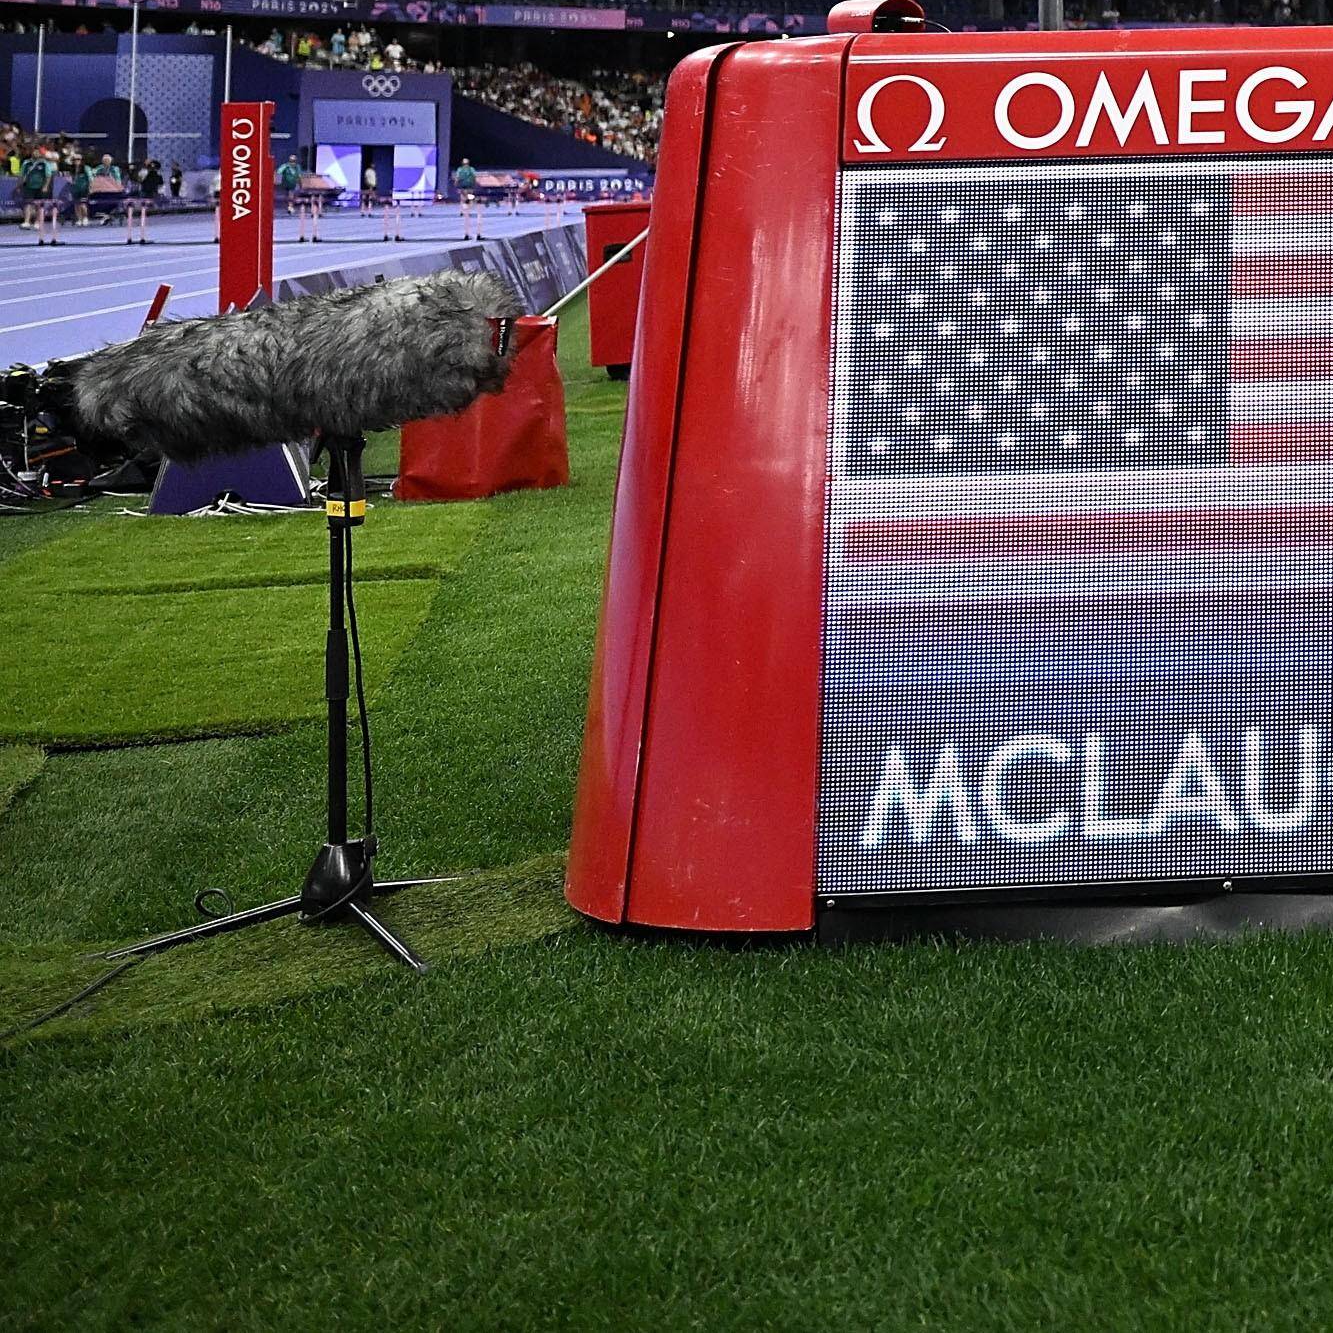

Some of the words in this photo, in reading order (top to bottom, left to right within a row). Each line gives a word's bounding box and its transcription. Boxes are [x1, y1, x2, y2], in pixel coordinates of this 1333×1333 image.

[299, 0, 338, 14] 2024
[232, 144, 252, 221] OMEGA
[545, 179, 594, 192] PARIS
[600, 179, 645, 192] 2024
